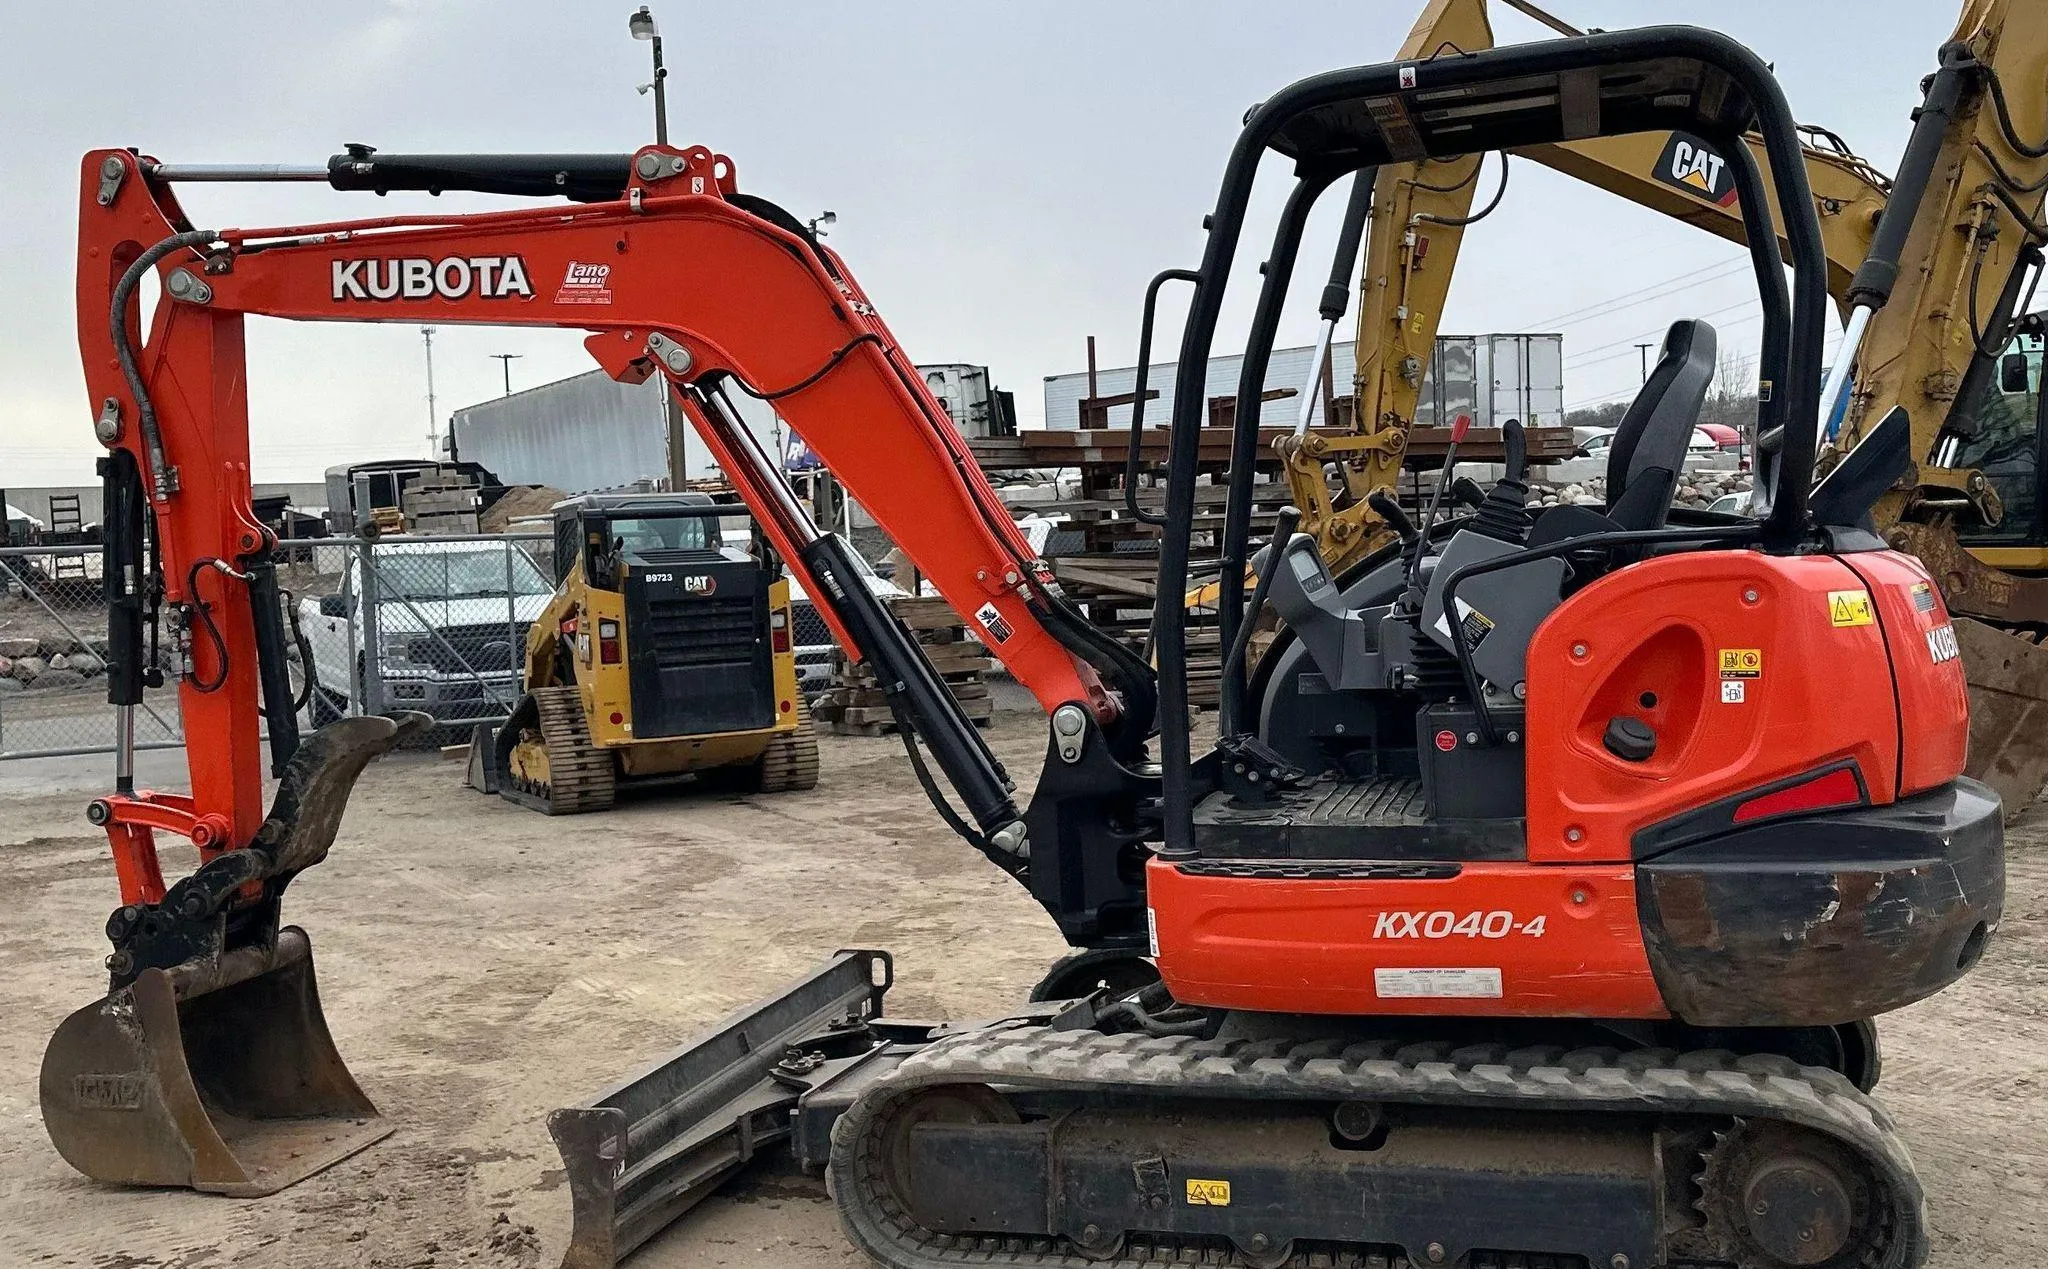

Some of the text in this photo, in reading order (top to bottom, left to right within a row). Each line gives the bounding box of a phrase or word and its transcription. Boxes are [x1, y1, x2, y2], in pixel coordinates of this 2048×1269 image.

[1671, 141, 1725, 194] CAT
[331, 256, 532, 299] KUBOTA
[564, 261, 611, 284] Lano
[645, 573, 673, 583] B9723
[684, 576, 709, 592] CAT
[1926, 625, 1959, 665] KUB
[1372, 910, 1547, 939] KX040-4
